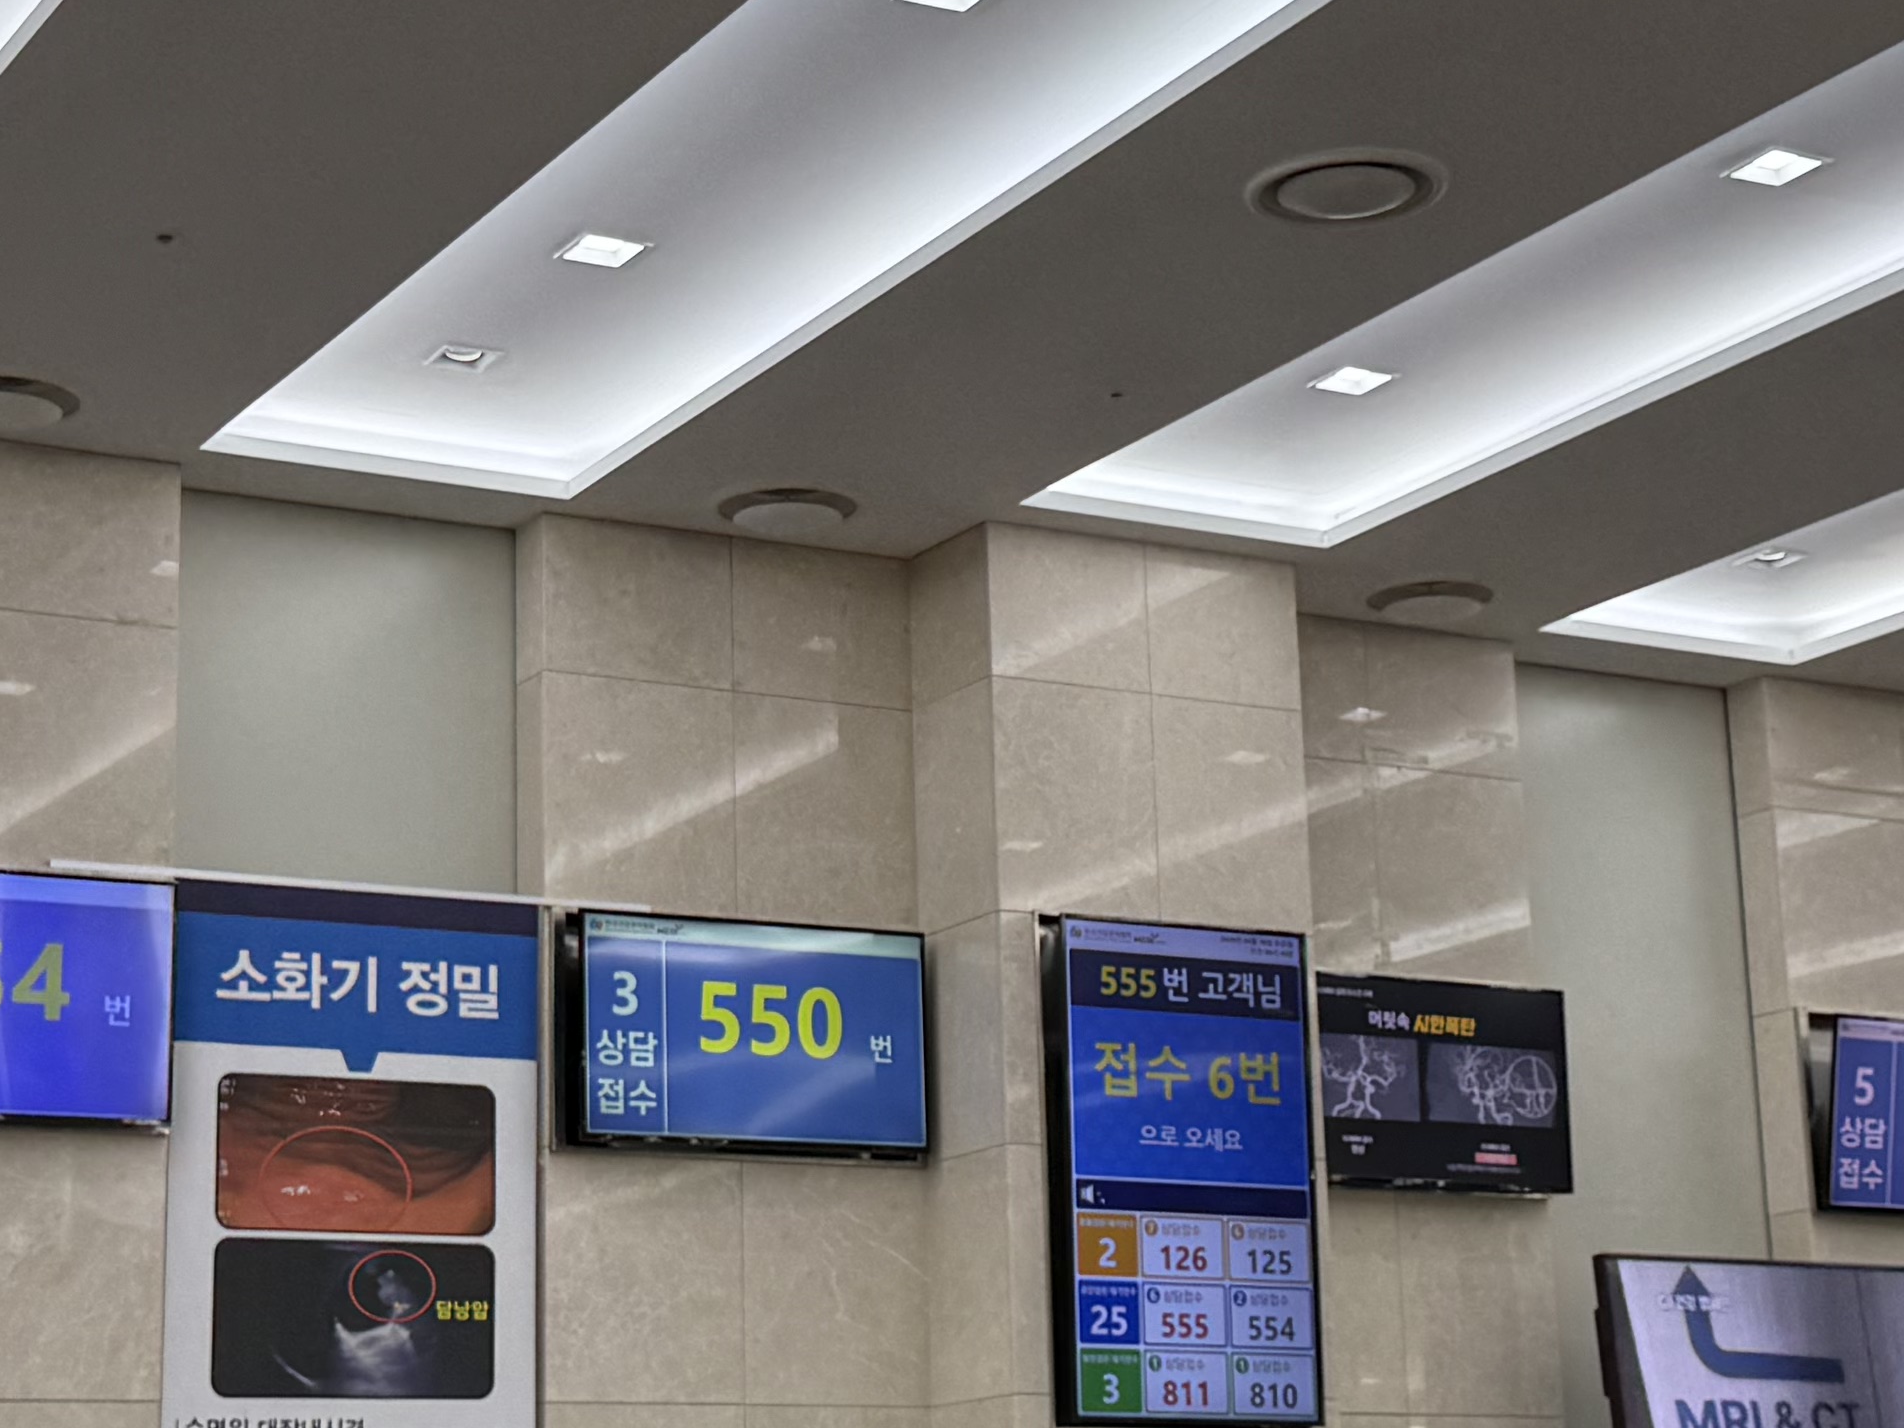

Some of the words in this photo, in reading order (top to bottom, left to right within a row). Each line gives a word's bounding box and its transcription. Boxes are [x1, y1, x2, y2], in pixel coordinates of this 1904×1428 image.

[215, 948, 379, 1014] 소화기
[399, 959, 501, 1020] 정밀
[612, 971, 638, 1016] 3
[1100, 966, 1157, 998] 555
[1163, 967, 1189, 1003] 번
[1198, 972, 1282, 1009] 고객님
[103, 994, 131, 1027] 번
[700, 980, 844, 1060] 550
[870, 1035, 893, 1064] 번
[596, 1029, 657, 1067] 상담
[1095, 1043, 1191, 1101] 접수
[1208, 1052, 1281, 1106] 6번
[1853, 1066, 1875, 1106] 5
[597, 1078, 657, 1115] 접수
[1139, 1125, 1179, 1147] 으로
[1184, 1126, 1243, 1152] 오세요
[1840, 1117, 1886, 1149] 상담
[1839, 1158, 1883, 1190] 접수
[1098, 1237, 1117, 1268] 2
[1161, 1246, 1208, 1271] 126
[1247, 1250, 1293, 1275] 125
[436, 1300, 488, 1321] 담낭암
[1090, 1305, 1128, 1336] 25
[1161, 1313, 1209, 1339] 555
[1248, 1317, 1295, 1341] 554
[1102, 1373, 1120, 1404] 3
[1163, 1381, 1209, 1406] 811
[1250, 1383, 1298, 1408] 810
